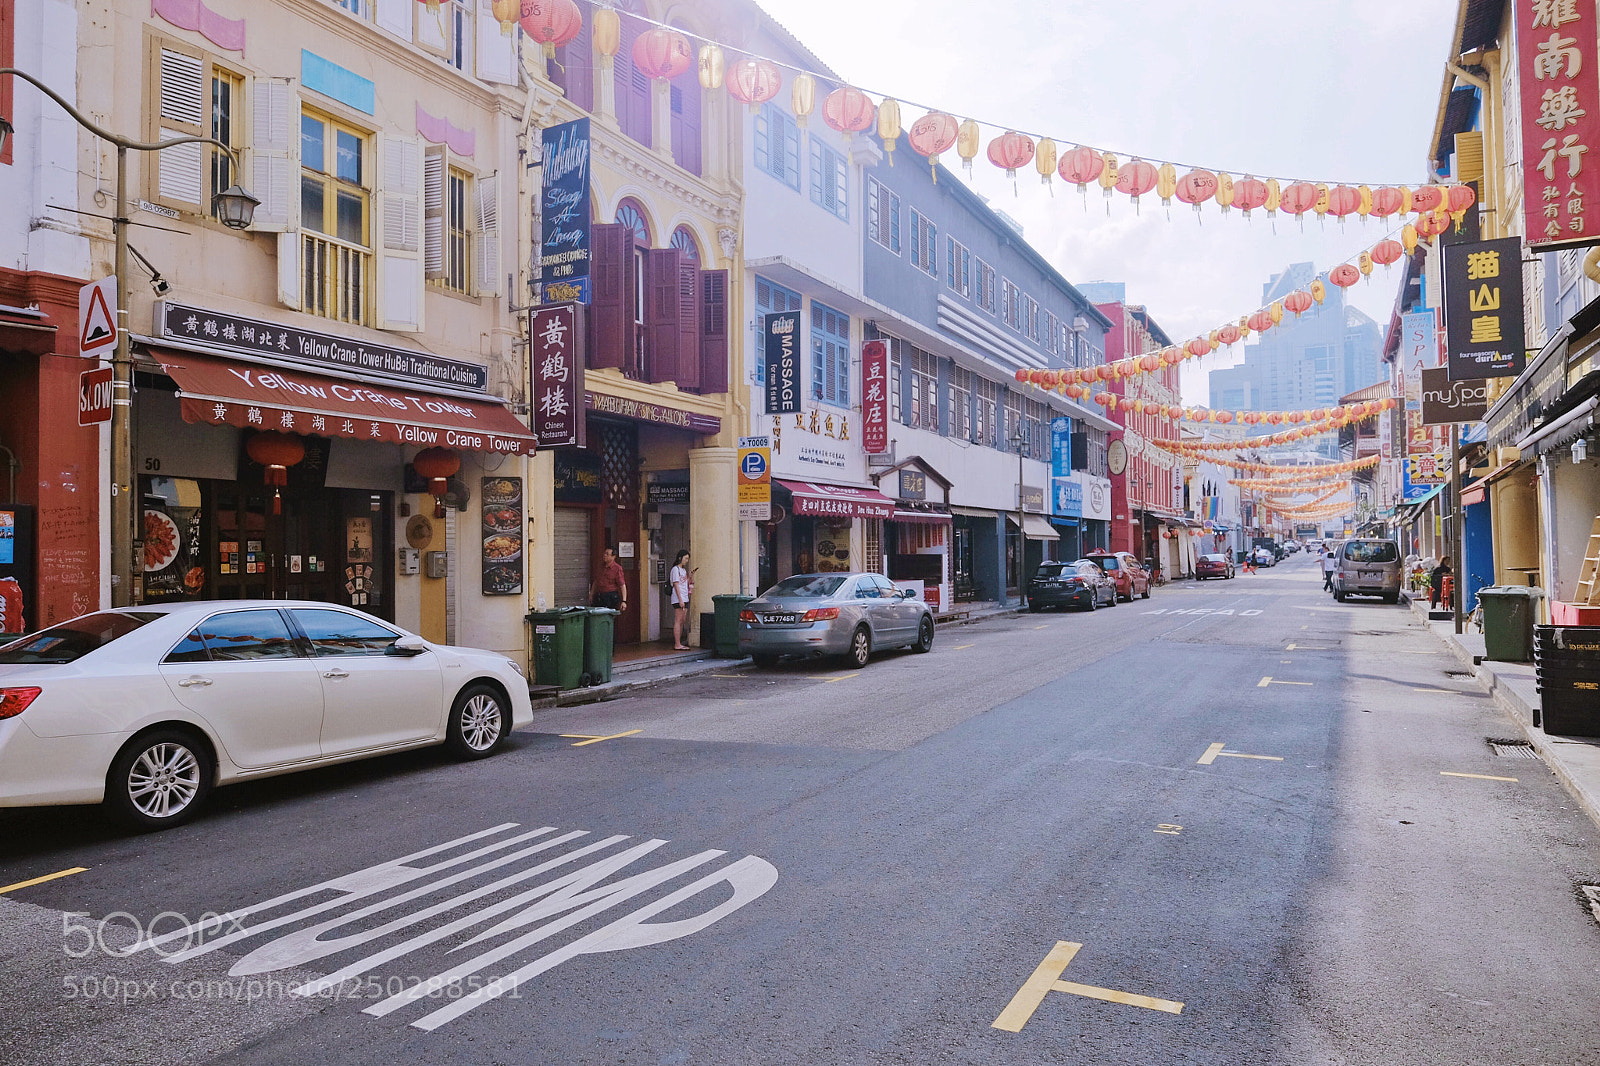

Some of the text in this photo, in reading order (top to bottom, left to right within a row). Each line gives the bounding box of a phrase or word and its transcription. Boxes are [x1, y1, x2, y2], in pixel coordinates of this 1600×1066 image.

[1467, 250, 1502, 343] 猫山皇
[298, 336, 329, 358] Yellow
[331, 342, 356, 363] Crane
[358, 347, 383, 368] Tower
[384, 353, 408, 373] HuBei
[410, 359, 450, 380] Traditional
[450, 367, 477, 384] Cuisine
[1411, 329, 1426, 371] SPA
[782, 334, 793, 410] MASSAGE
[80, 381, 112, 412] SLOW
[228, 368, 477, 418] Yellow Crane Tower
[395, 424, 437, 443] Yellow
[446, 431, 481, 447] Crane
[488, 435, 521, 452] Tower
[541, 429, 568, 439] Restaurant
[544, 421, 564, 430] Chinese
[145, 458, 160, 471] 50
[1140, 608, 1264, 616] AHEAD
[120, 823, 778, 1031] HUMP
